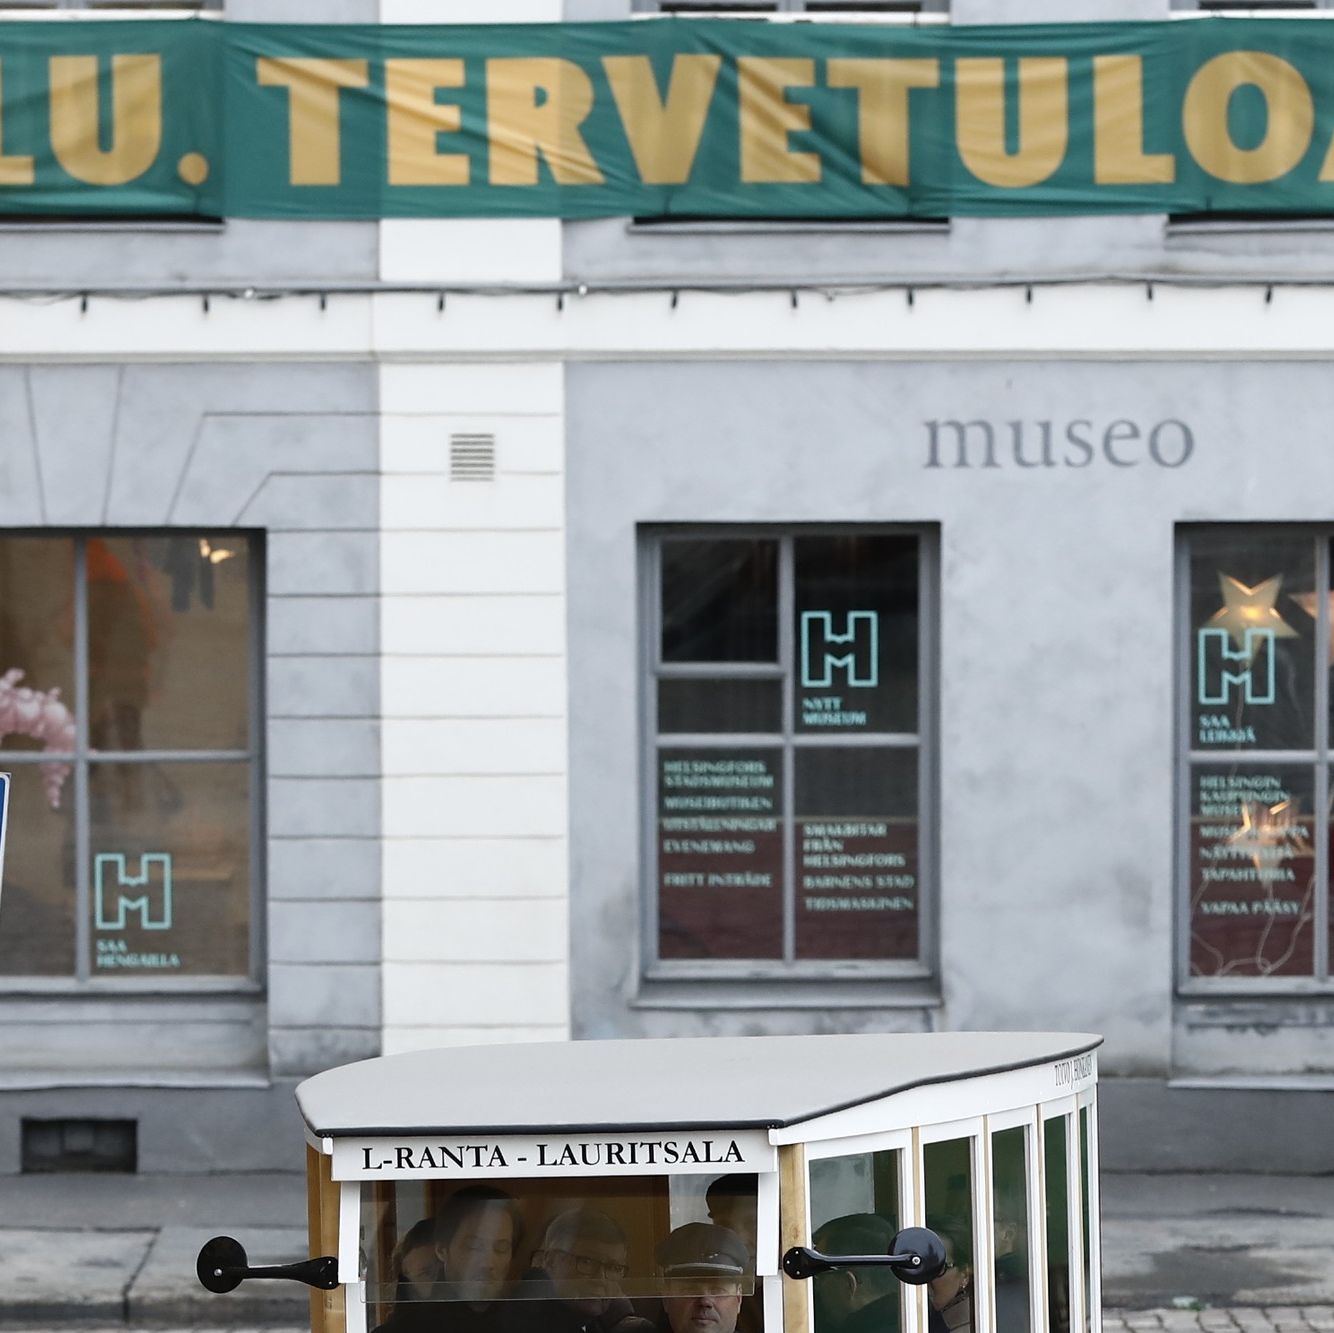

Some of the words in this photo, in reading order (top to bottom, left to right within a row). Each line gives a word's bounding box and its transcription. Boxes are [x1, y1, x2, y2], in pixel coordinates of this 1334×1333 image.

[922, 416, 1196, 470] museo
[803, 711, 867, 725] MUSEUM
[664, 760, 766, 774] HELSINGFORS
[1200, 775, 1282, 788] HELSINGIN
[664, 839, 756, 854] EVENEMANG
[803, 853, 906, 868] HELSINGFORS
[803, 874, 873, 889] BARNENS
[1201, 901, 1249, 915] VAPAA
[97, 939, 128, 953] SAA
[362, 1144, 509, 1171] L-RANTA
[536, 1139, 746, 1167] LAURITSALA
